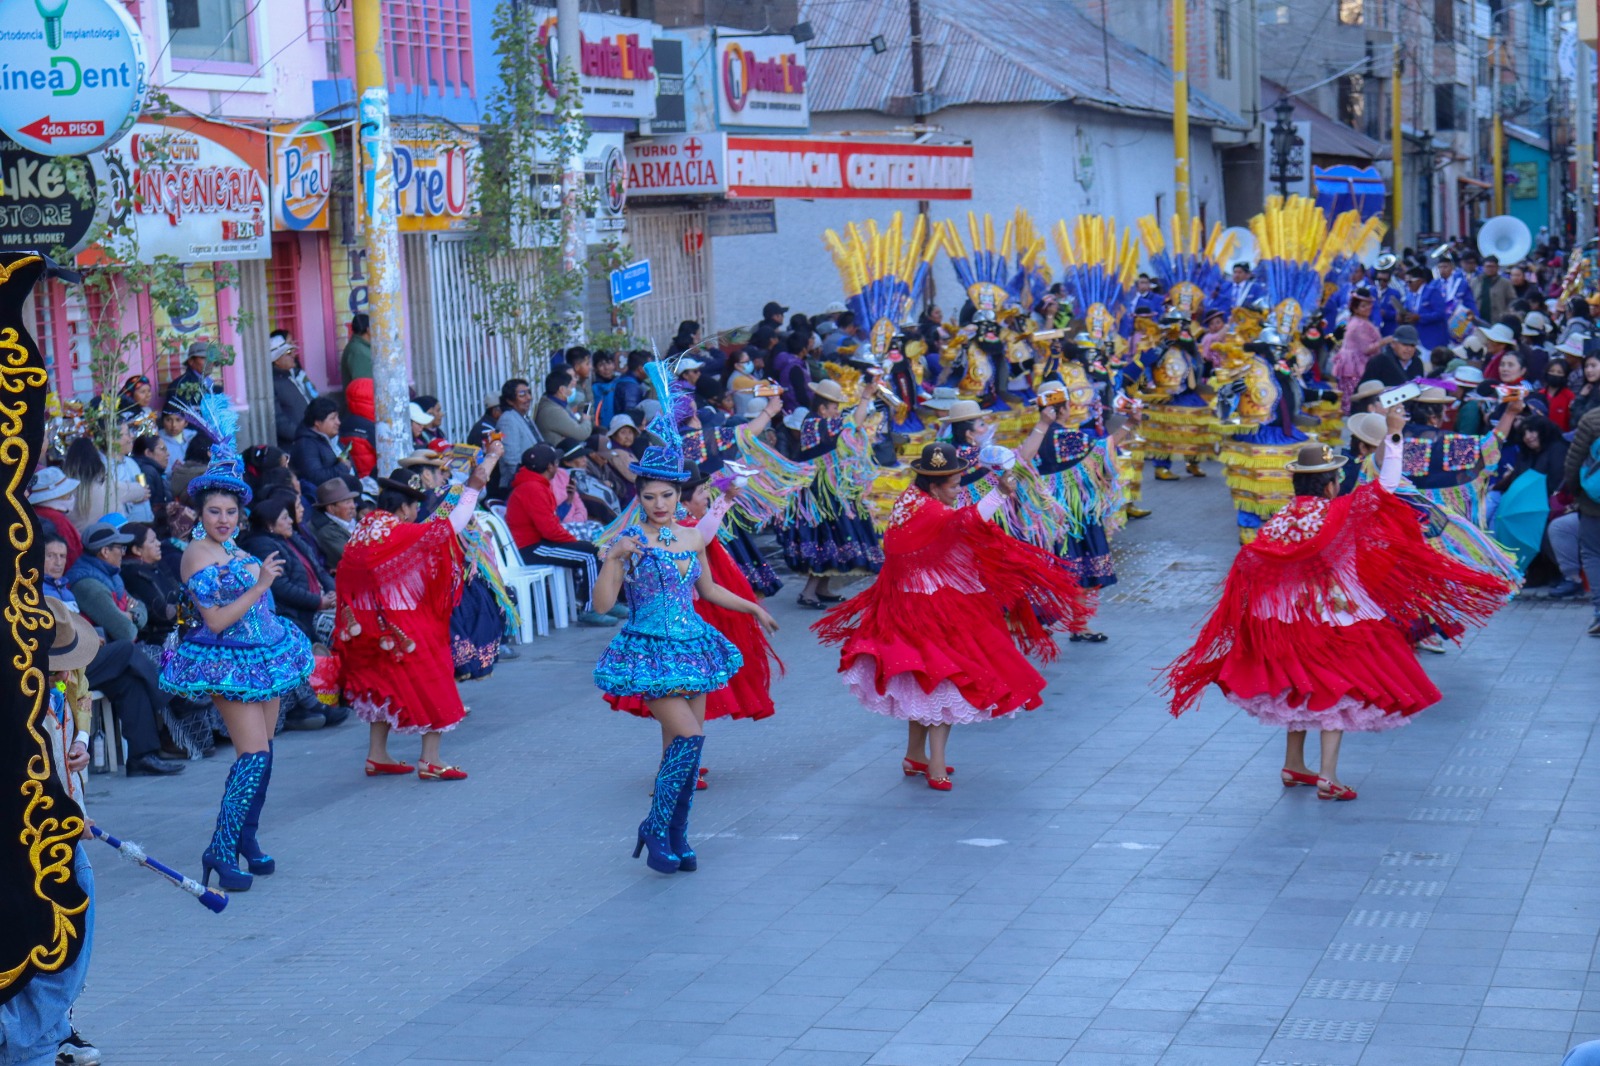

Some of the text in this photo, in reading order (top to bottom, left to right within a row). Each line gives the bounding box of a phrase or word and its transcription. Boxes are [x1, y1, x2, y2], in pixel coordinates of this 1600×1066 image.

[0, 56, 130, 97] íneaDent
[69, 123, 97, 135] PISO
[633, 144, 677, 157] TURNO
[627, 159, 719, 189] ARMACIA
[728, 149, 973, 190] FARMACIA CENTENARIA
[2, 233, 22, 245] VAPE
[24, 233, 31, 243] &
